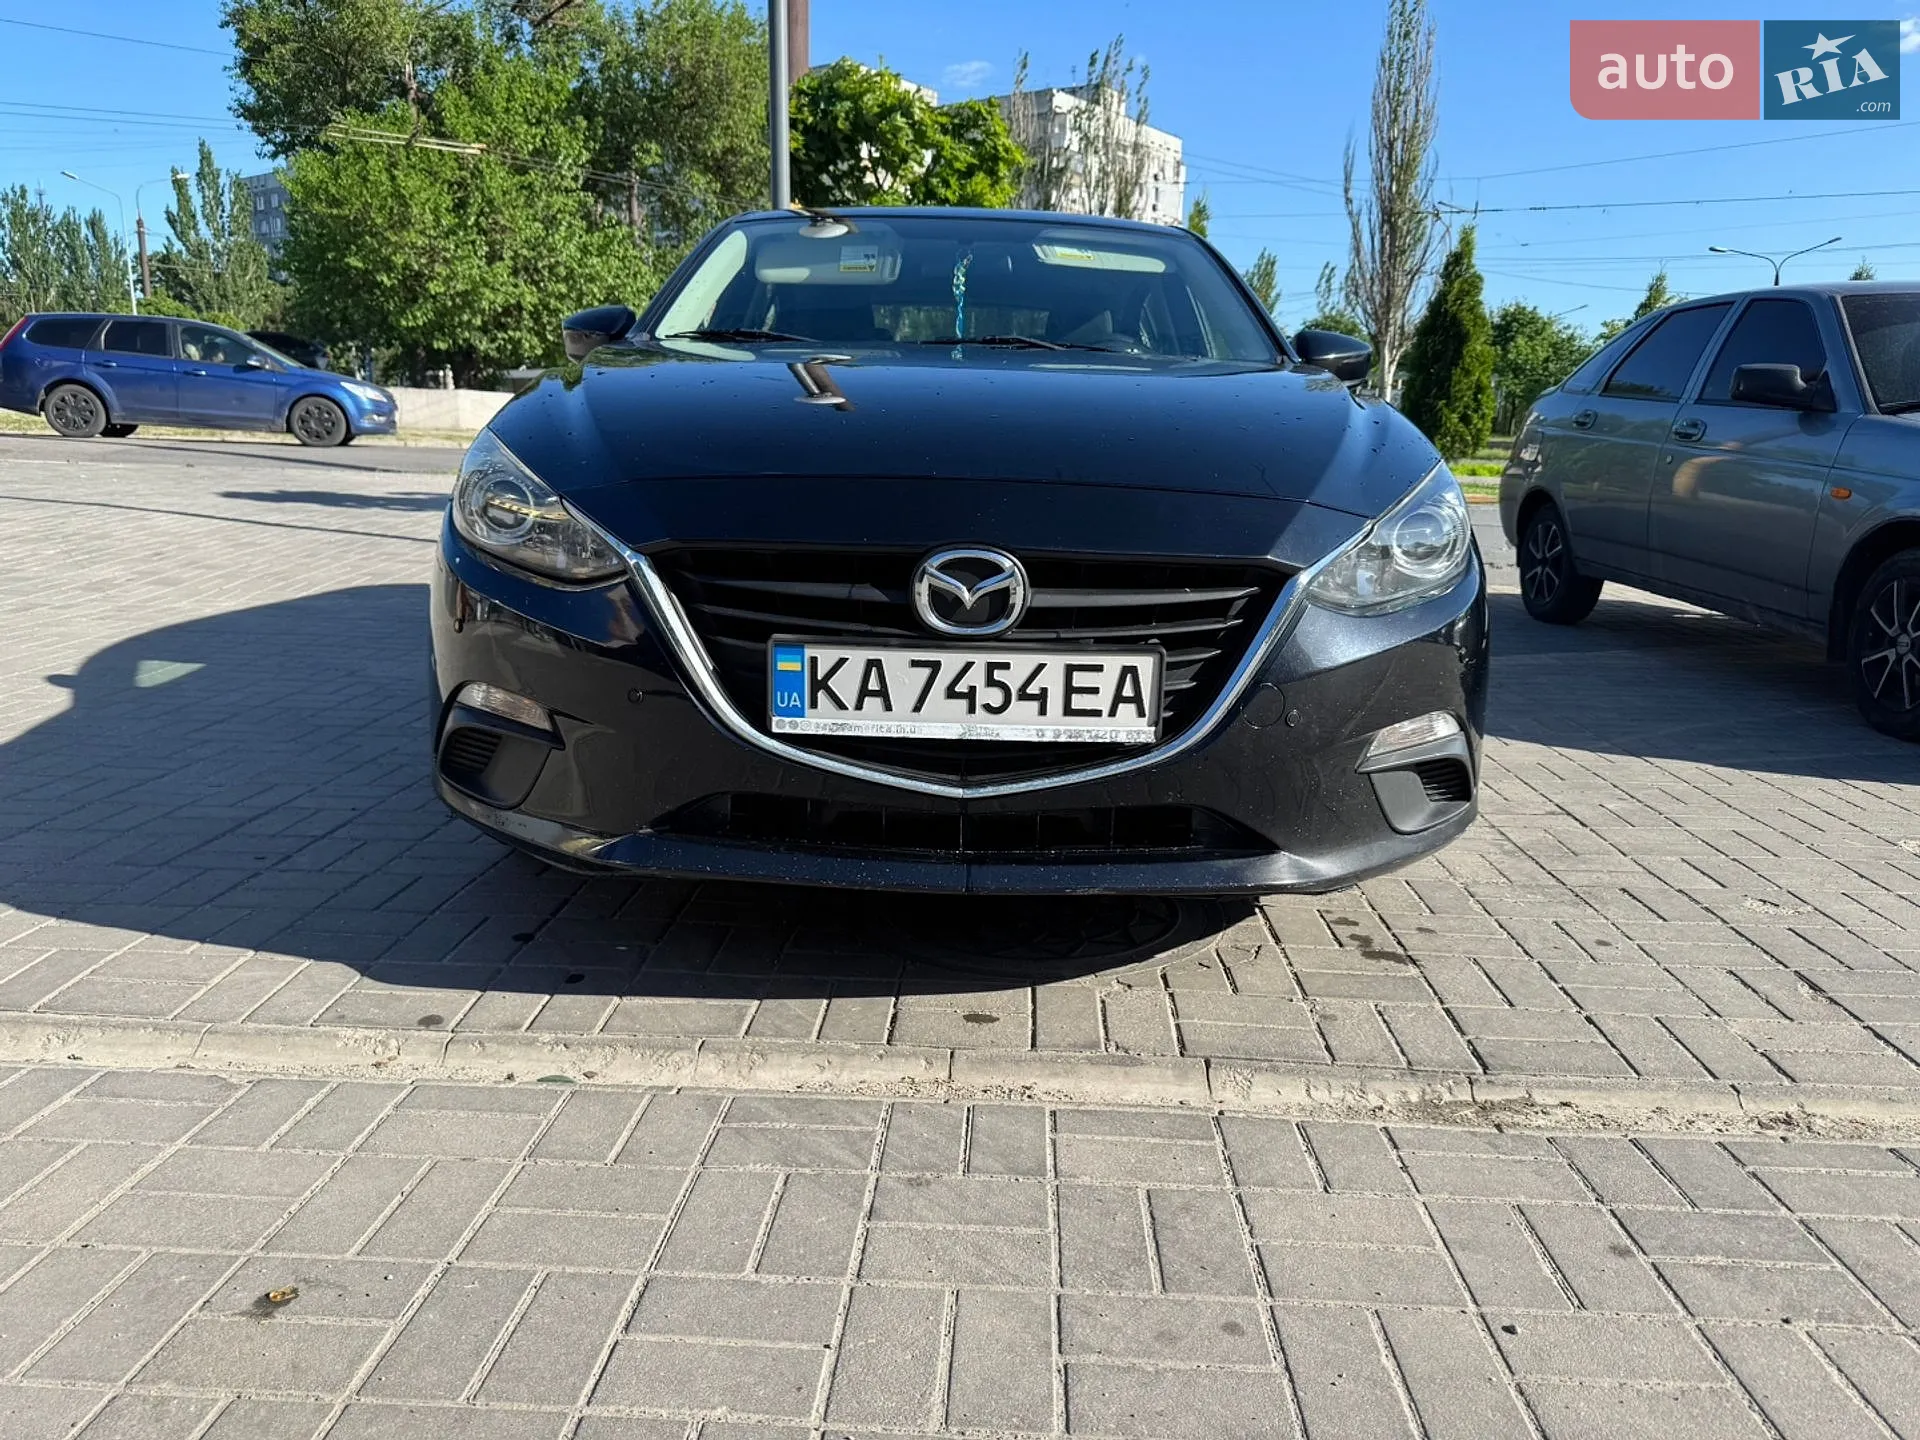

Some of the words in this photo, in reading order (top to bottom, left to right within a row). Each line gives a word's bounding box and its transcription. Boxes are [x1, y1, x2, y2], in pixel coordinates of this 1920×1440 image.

[776, 691, 802, 708] UA
[808, 655, 893, 712] KA
[909, 659, 1049, 717] 7454
[1062, 663, 1147, 718] EA
